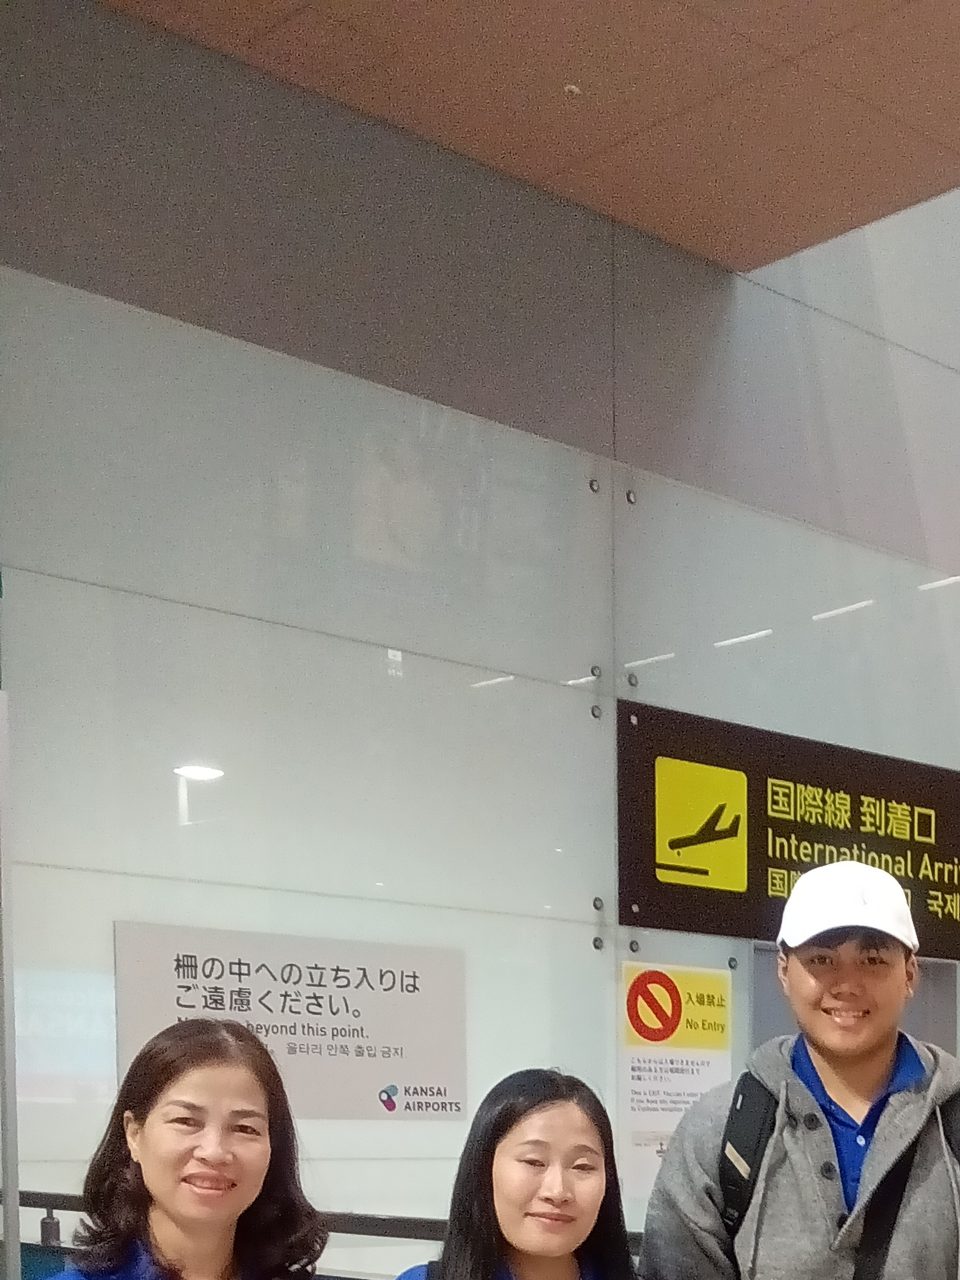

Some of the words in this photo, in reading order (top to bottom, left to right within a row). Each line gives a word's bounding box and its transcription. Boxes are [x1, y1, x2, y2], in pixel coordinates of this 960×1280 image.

[767, 778, 851, 829] 国際線
[860, 795, 936, 845] 到着口
[767, 828, 913, 878] International
[173, 953, 420, 994] 柵の中への立ち入りは
[176, 984, 361, 1018] ご遠慮ください。
[246, 1021, 297, 1038] beyond
[301, 1023, 327, 1037] this
[332, 1025, 370, 1041] point.
[686, 1018, 699, 1030] No
[702, 1019, 726, 1034] Entry
[404, 1085, 448, 1098] KANSAI
[404, 1100, 461, 1112] AIRPORTS
